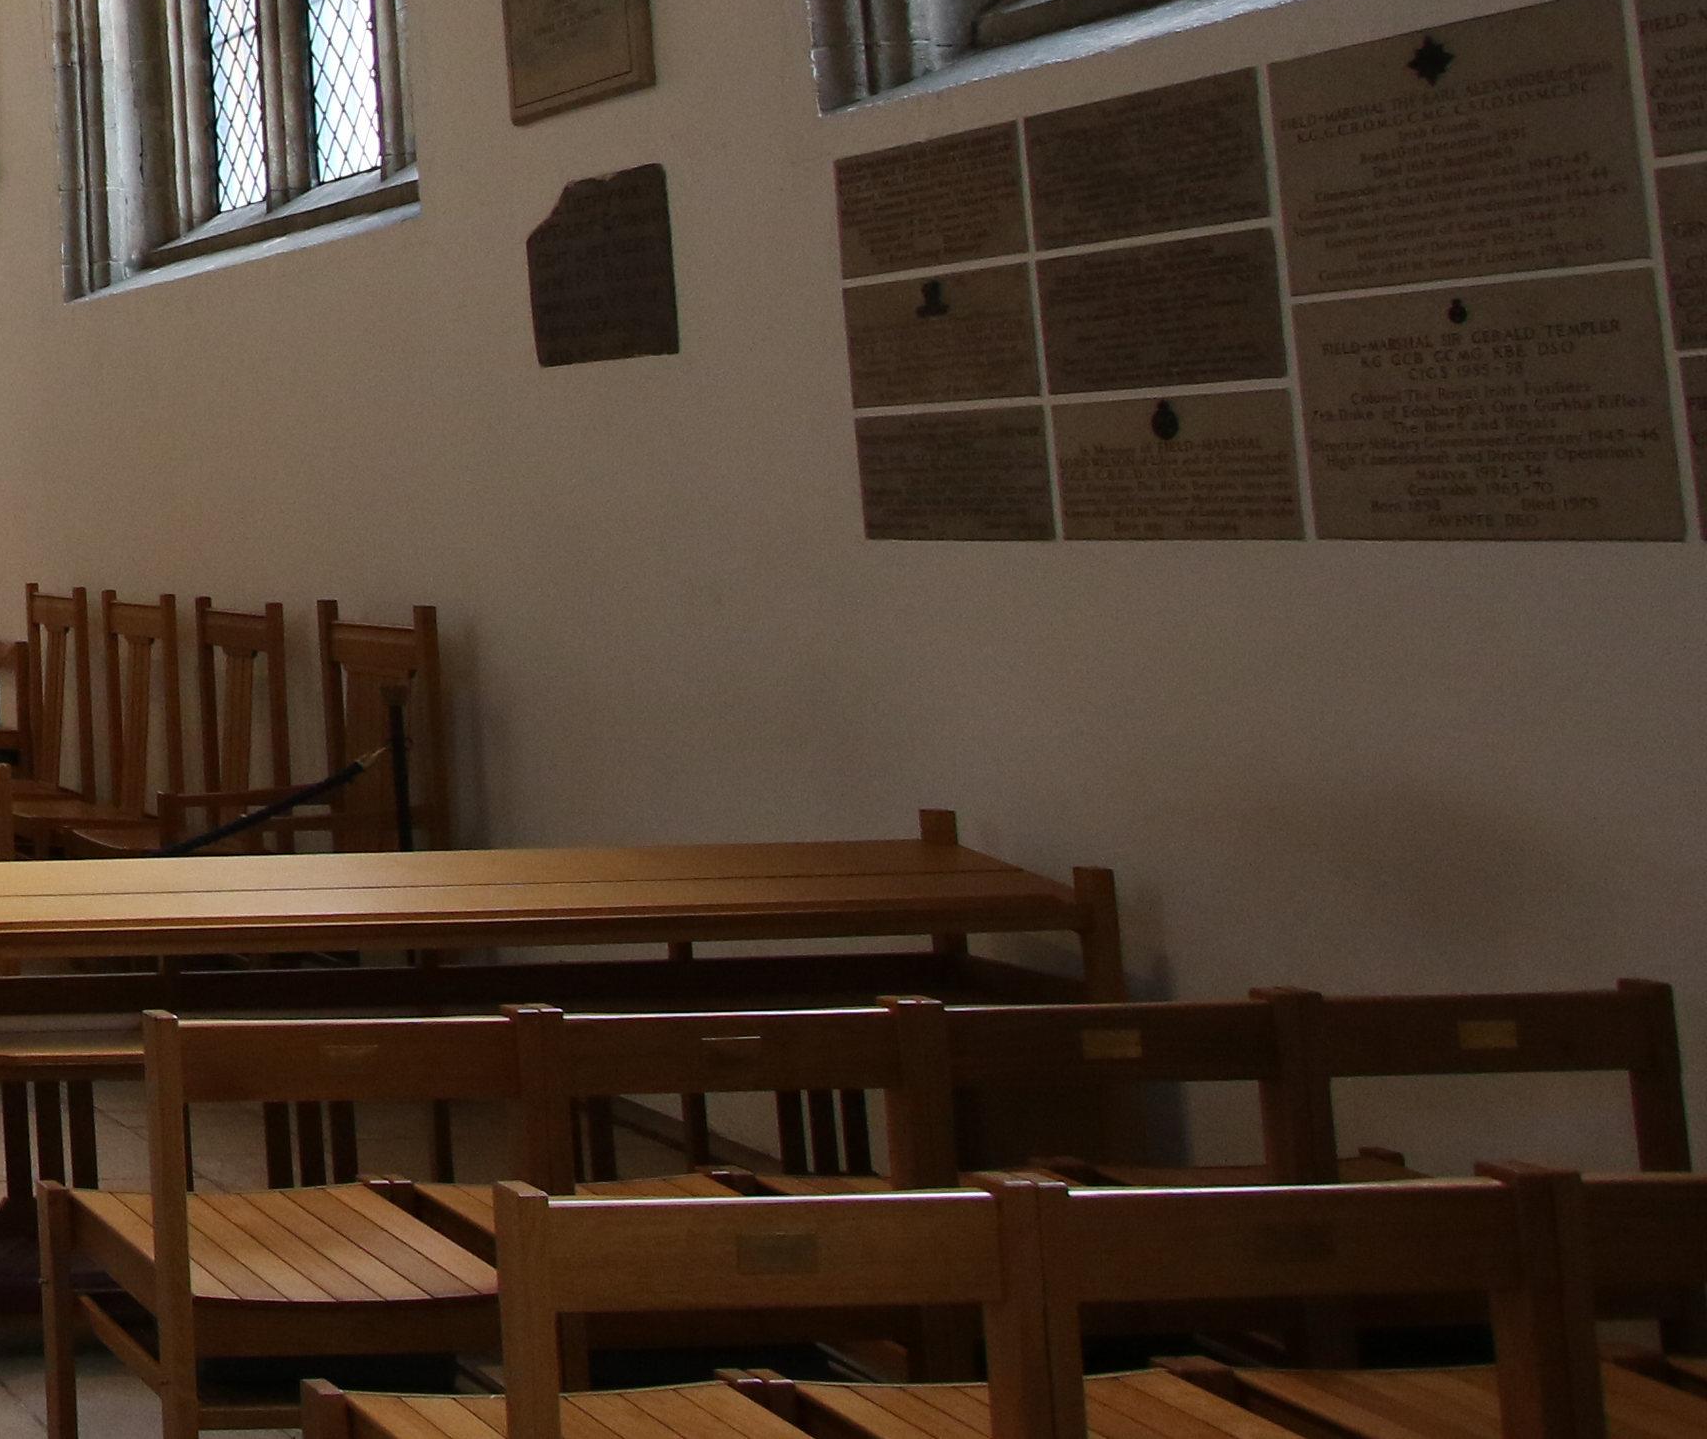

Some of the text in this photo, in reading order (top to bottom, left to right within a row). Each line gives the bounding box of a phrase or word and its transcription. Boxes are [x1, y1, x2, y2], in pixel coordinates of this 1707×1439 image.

[1280, 102, 1386, 131] FIELD-MARSHAL
[1322, 318, 1622, 356] FIELD-MARSHAL SIR GERALD TEMPLER
[1390, 351, 1423, 366] GCB
[1433, 347, 1484, 363] GCMG
[1492, 343, 1527, 359] KBE
[1538, 340, 1574, 356] DSO
[1351, 391, 1402, 405] Colonel
[1438, 386, 1479, 400] Royal
[1338, 408, 1375, 421] Duke
[1534, 397, 1592, 411] Gurkha
[1597, 394, 1647, 409] Rifles
[1392, 421, 1418, 434] The
[1521, 498, 1556, 511] Died
[1505, 514, 1538, 527] DEO
